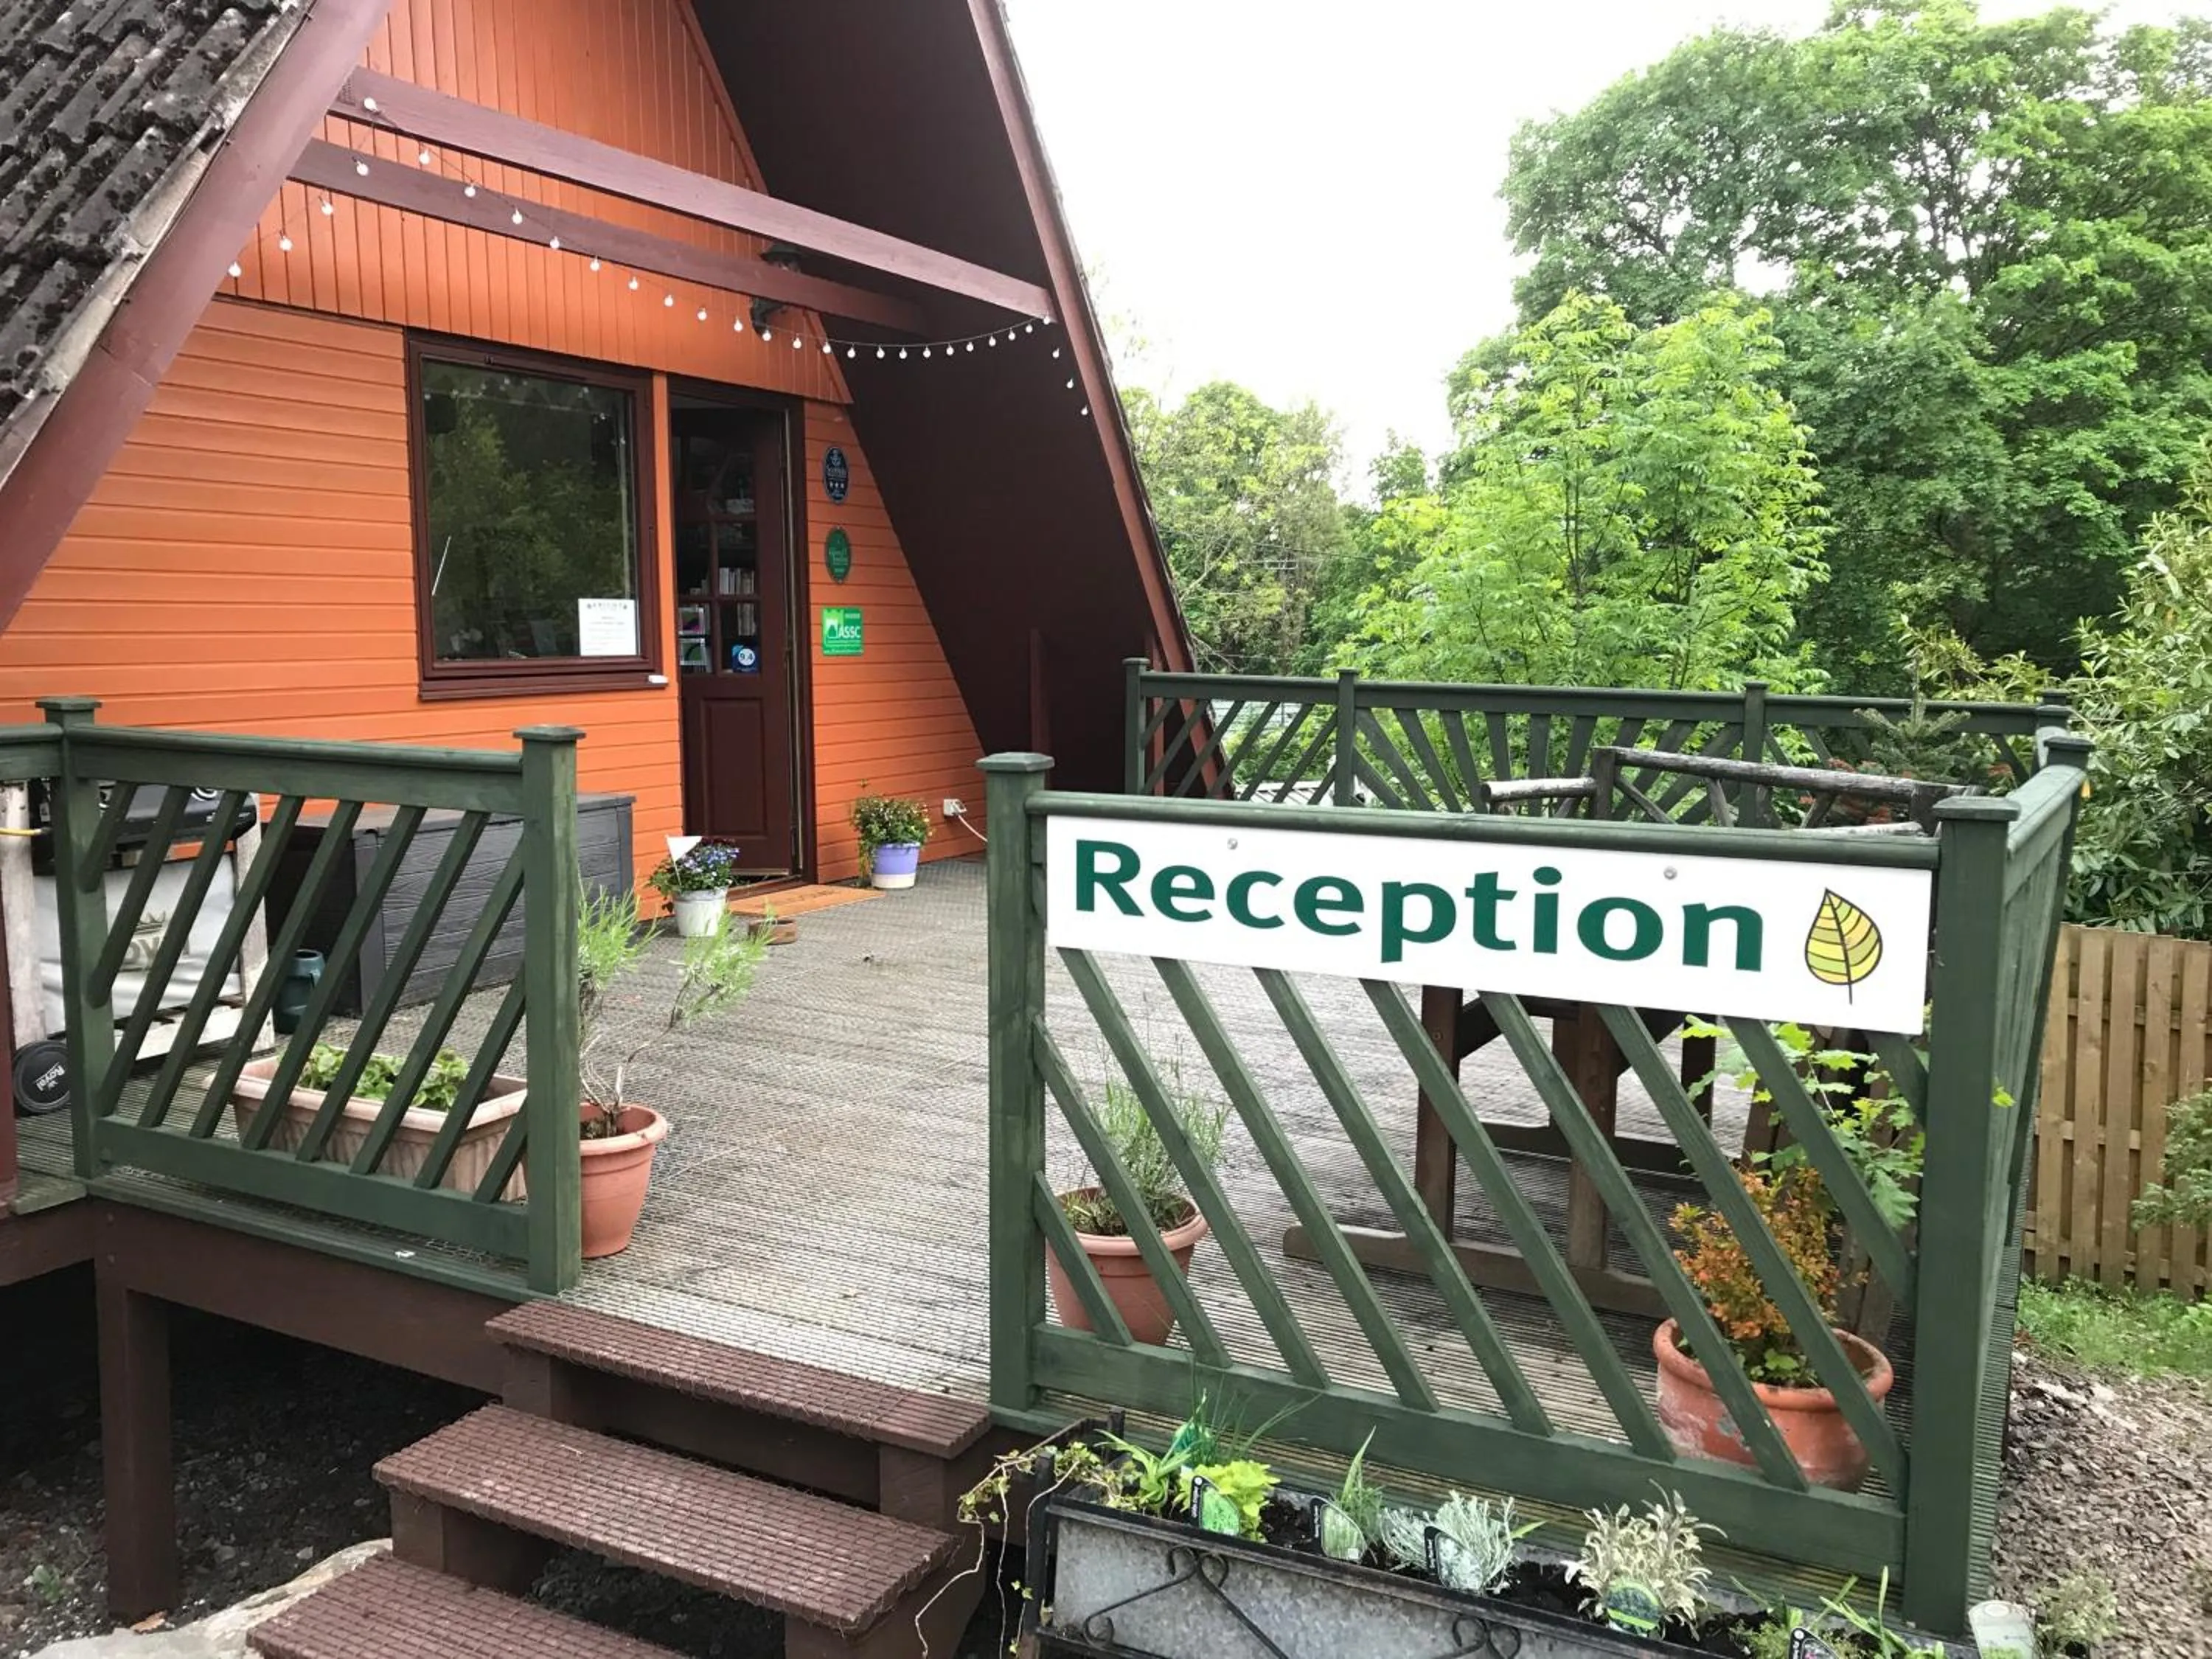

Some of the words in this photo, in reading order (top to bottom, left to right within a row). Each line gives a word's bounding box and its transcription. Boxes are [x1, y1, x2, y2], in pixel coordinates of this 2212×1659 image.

[838, 625, 861, 639] ASSC
[1077, 839, 1763, 972] Reception
[35, 1064, 66, 1092] Royal
